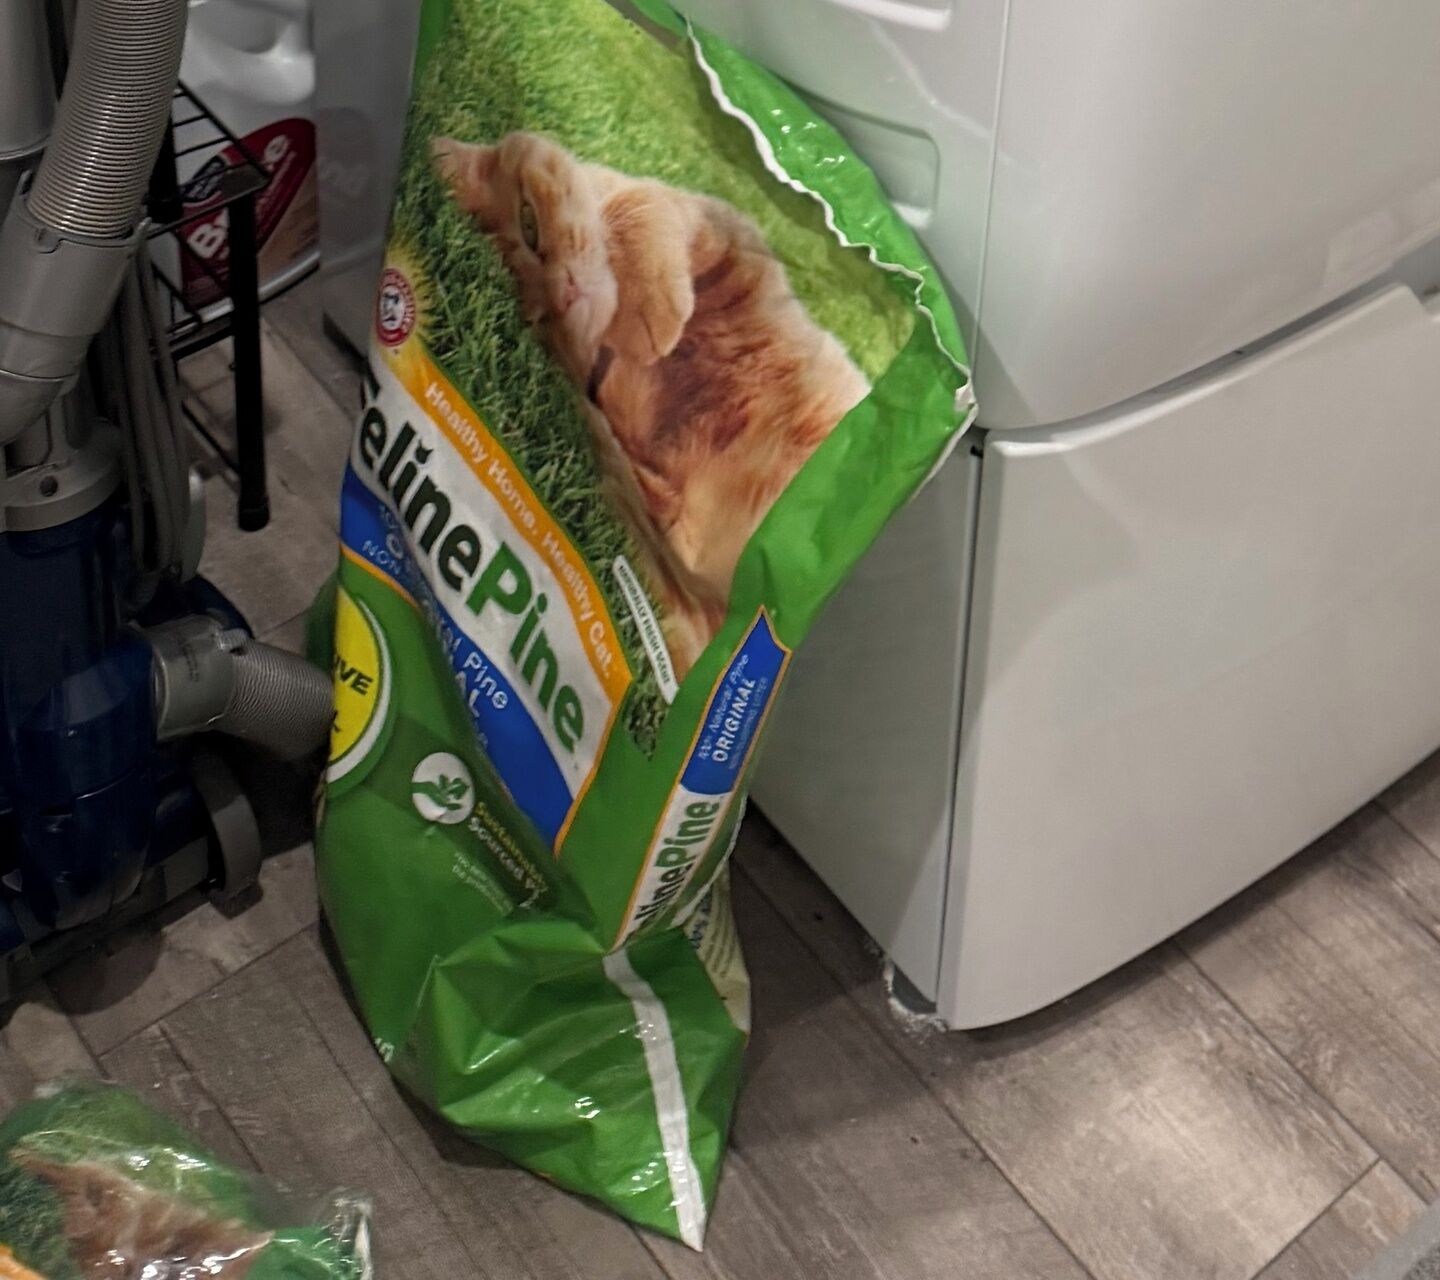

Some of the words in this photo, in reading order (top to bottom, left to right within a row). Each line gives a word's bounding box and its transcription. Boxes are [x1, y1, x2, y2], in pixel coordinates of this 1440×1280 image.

[359, 370, 584, 754] elinePine
[425, 381, 489, 463] Healthy
[487, 457, 539, 536] Home.
[542, 531, 596, 624] Healthy
[588, 615, 615, 680] Cat.
[618, 564, 646, 618] NATURALLY
[643, 619, 661, 651] FRESH
[655, 650, 670, 684] SCENT
[464, 650, 509, 710] Pine
[708, 684, 734, 733] Natural
[729, 653, 750, 684] Pine
[711, 678, 756, 763] ORIGINAL
